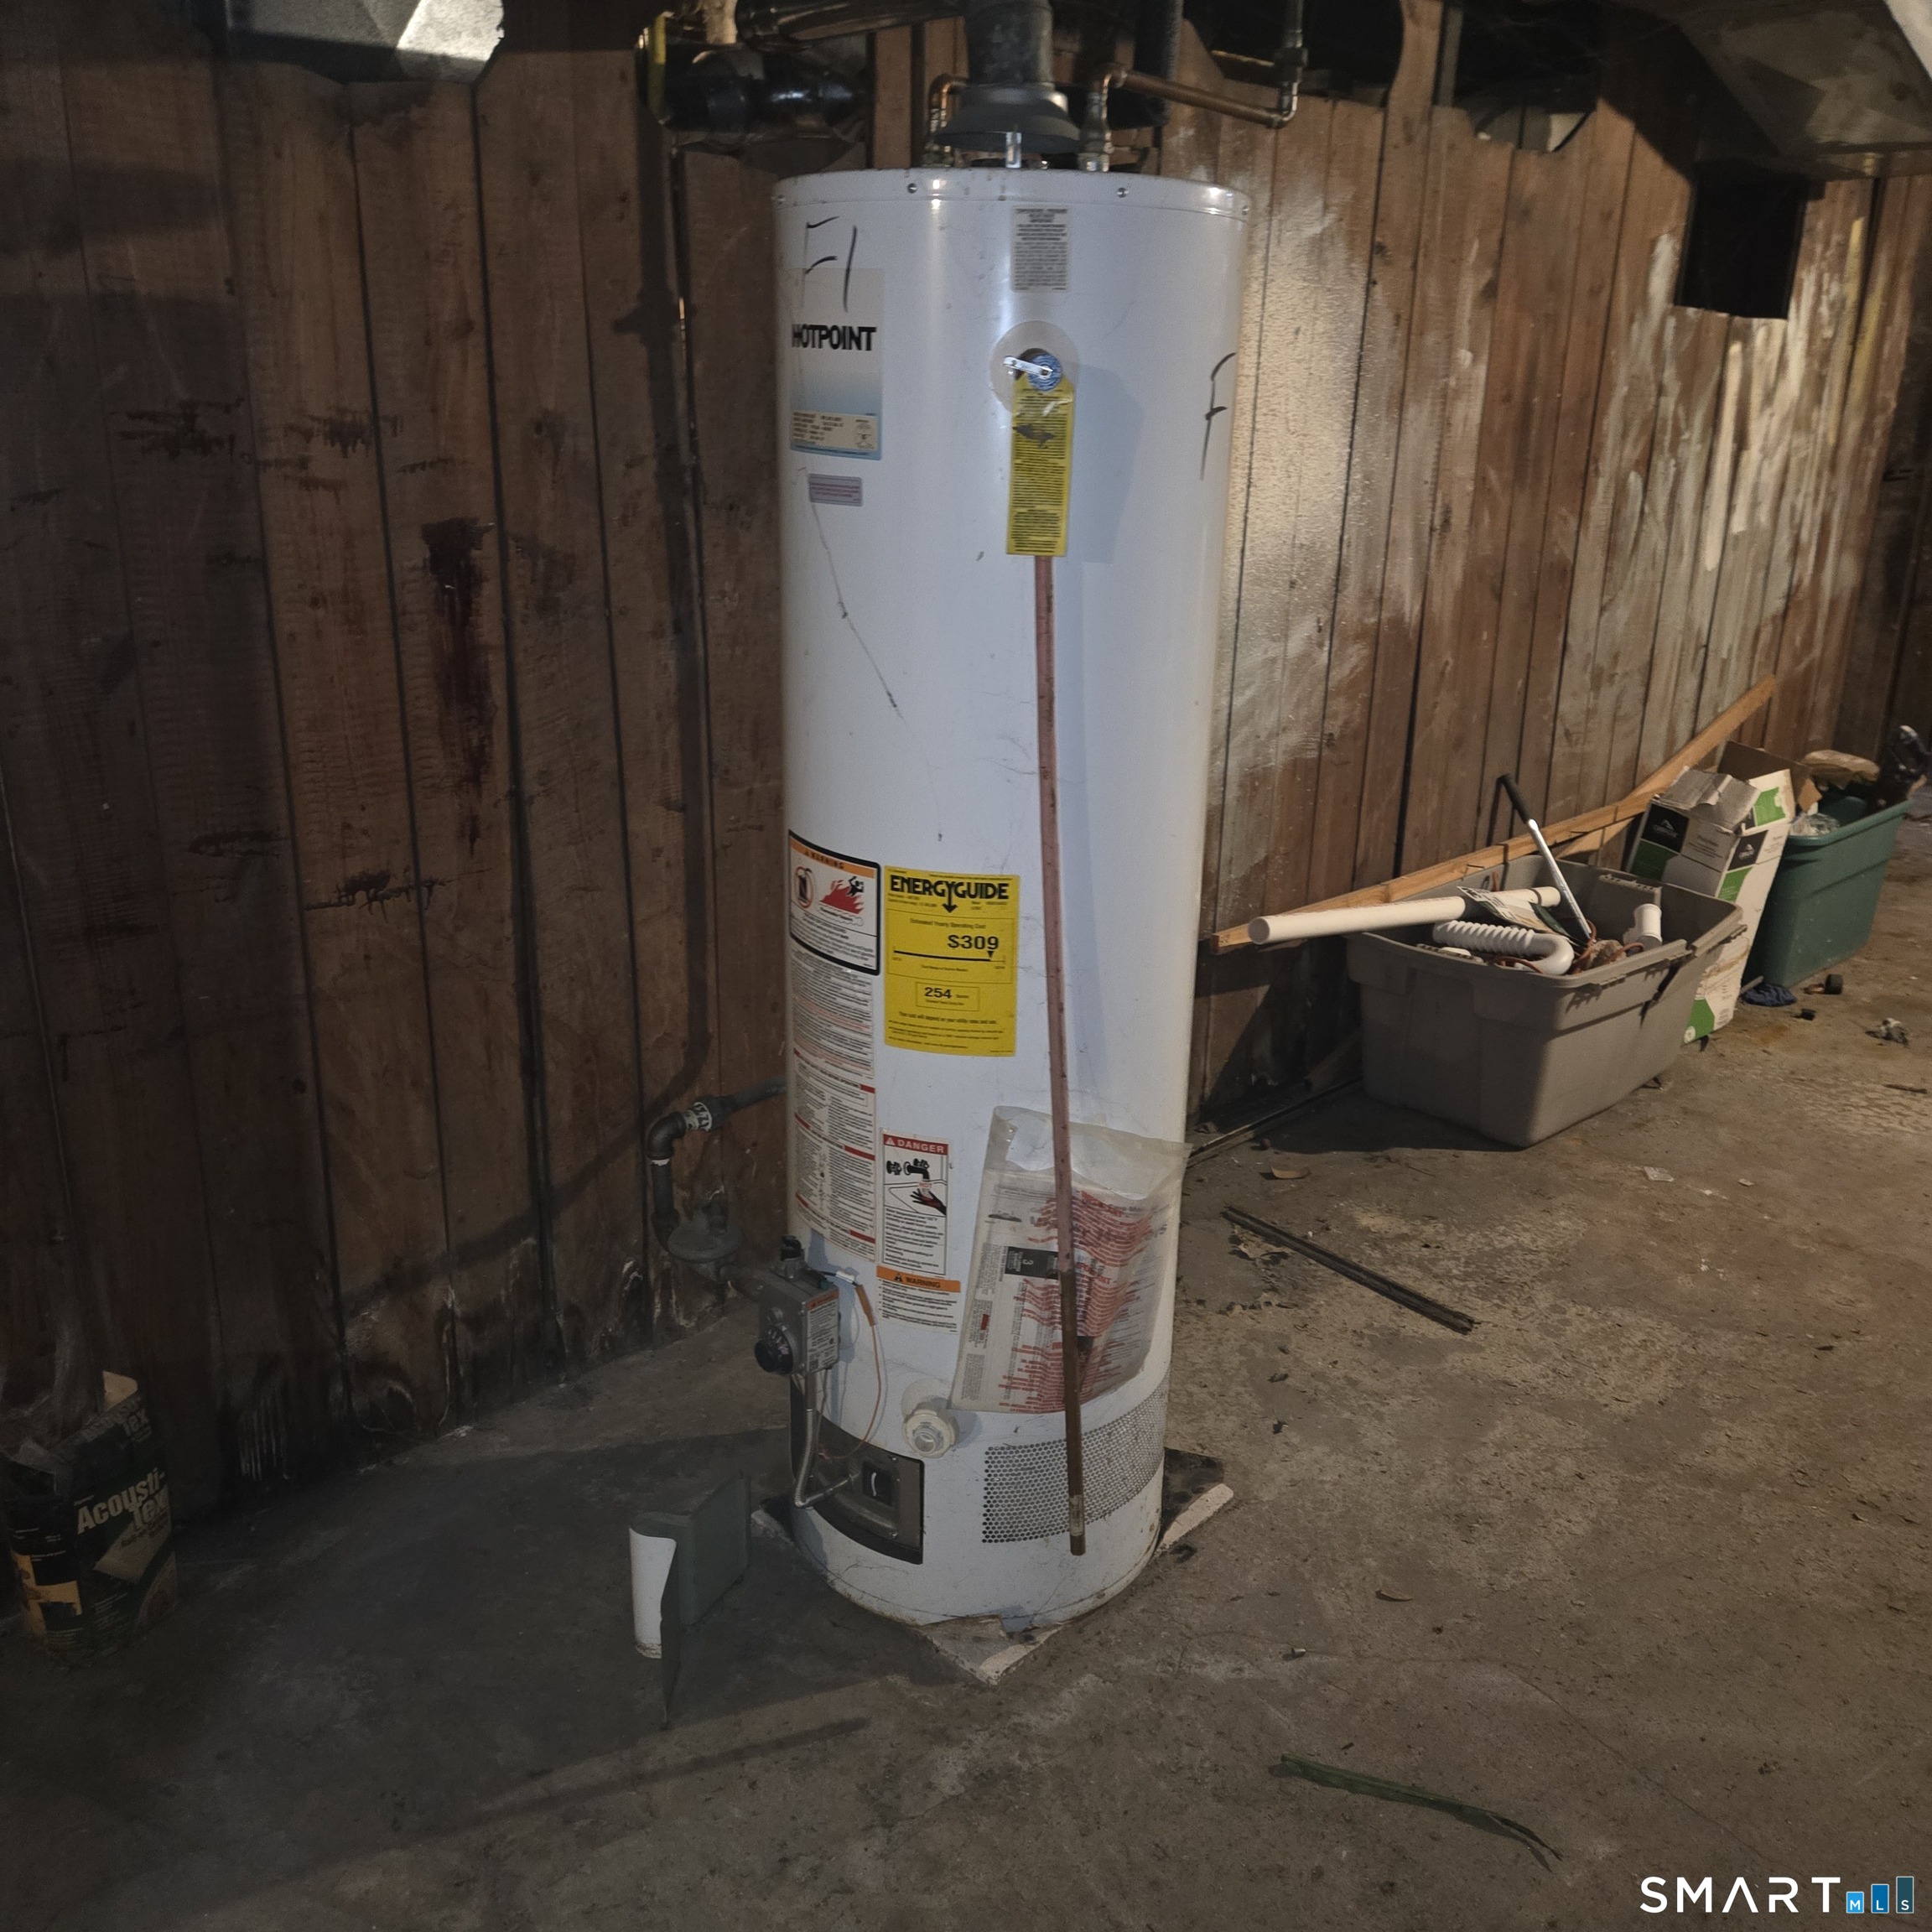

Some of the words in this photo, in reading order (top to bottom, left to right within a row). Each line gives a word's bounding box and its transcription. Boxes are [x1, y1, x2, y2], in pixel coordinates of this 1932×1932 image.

[791, 324, 877, 351] HOTPOINT
[891, 875, 1010, 900] ENERGYGUIDE
[923, 986, 953, 1000] 254
[896, 1139, 945, 1154] DANGER
[905, 1276, 942, 1289] WARNING
